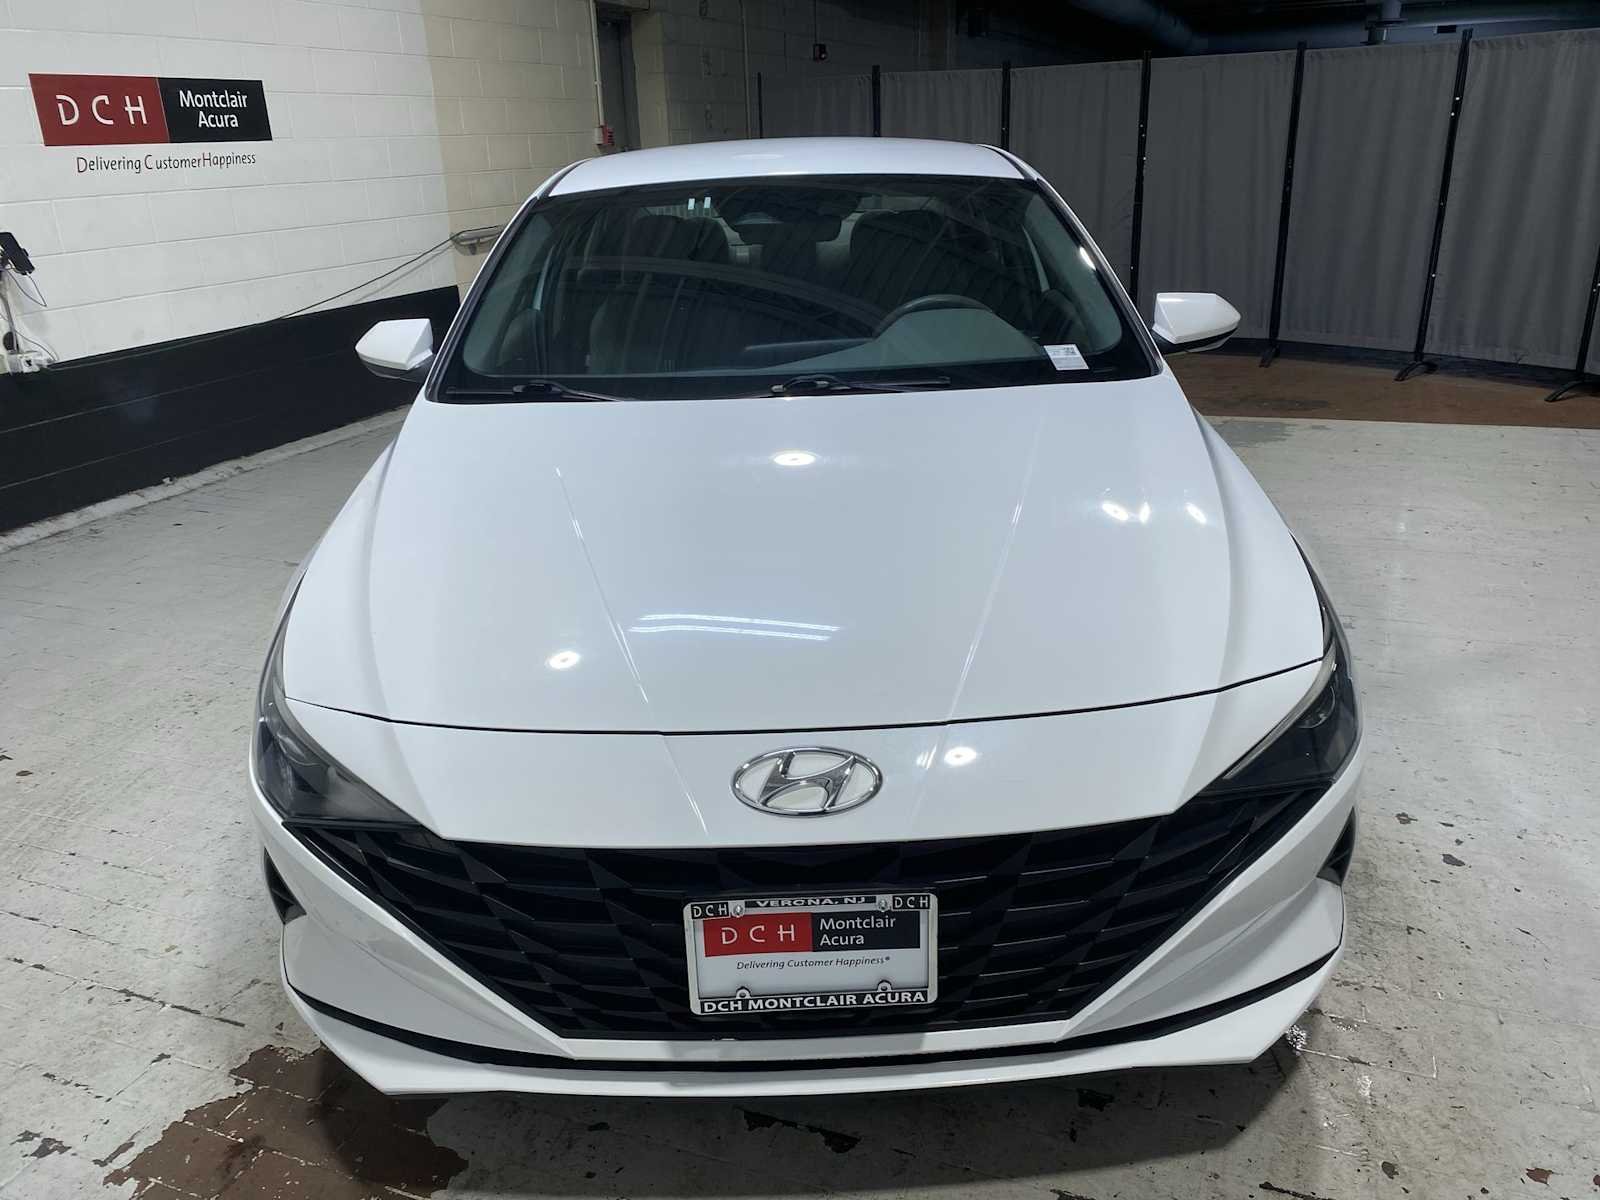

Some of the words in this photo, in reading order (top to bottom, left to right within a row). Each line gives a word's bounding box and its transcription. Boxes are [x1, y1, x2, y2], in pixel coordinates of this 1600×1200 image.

[179, 90, 248, 107] Montclair
[198, 111, 239, 127] Acura
[76, 155, 141, 174] Delivering
[144, 154, 201, 169] Customer
[202, 152, 256, 167] Happiness
[844, 896, 866, 904] NJ
[820, 917, 896, 929] Montclair
[820, 934, 865, 946] Acura
[737, 961, 785, 969] Delivering
[787, 958, 833, 968] Customer
[748, 994, 857, 1011] MONTCLAIR
[863, 992, 925, 1004] ACURA
